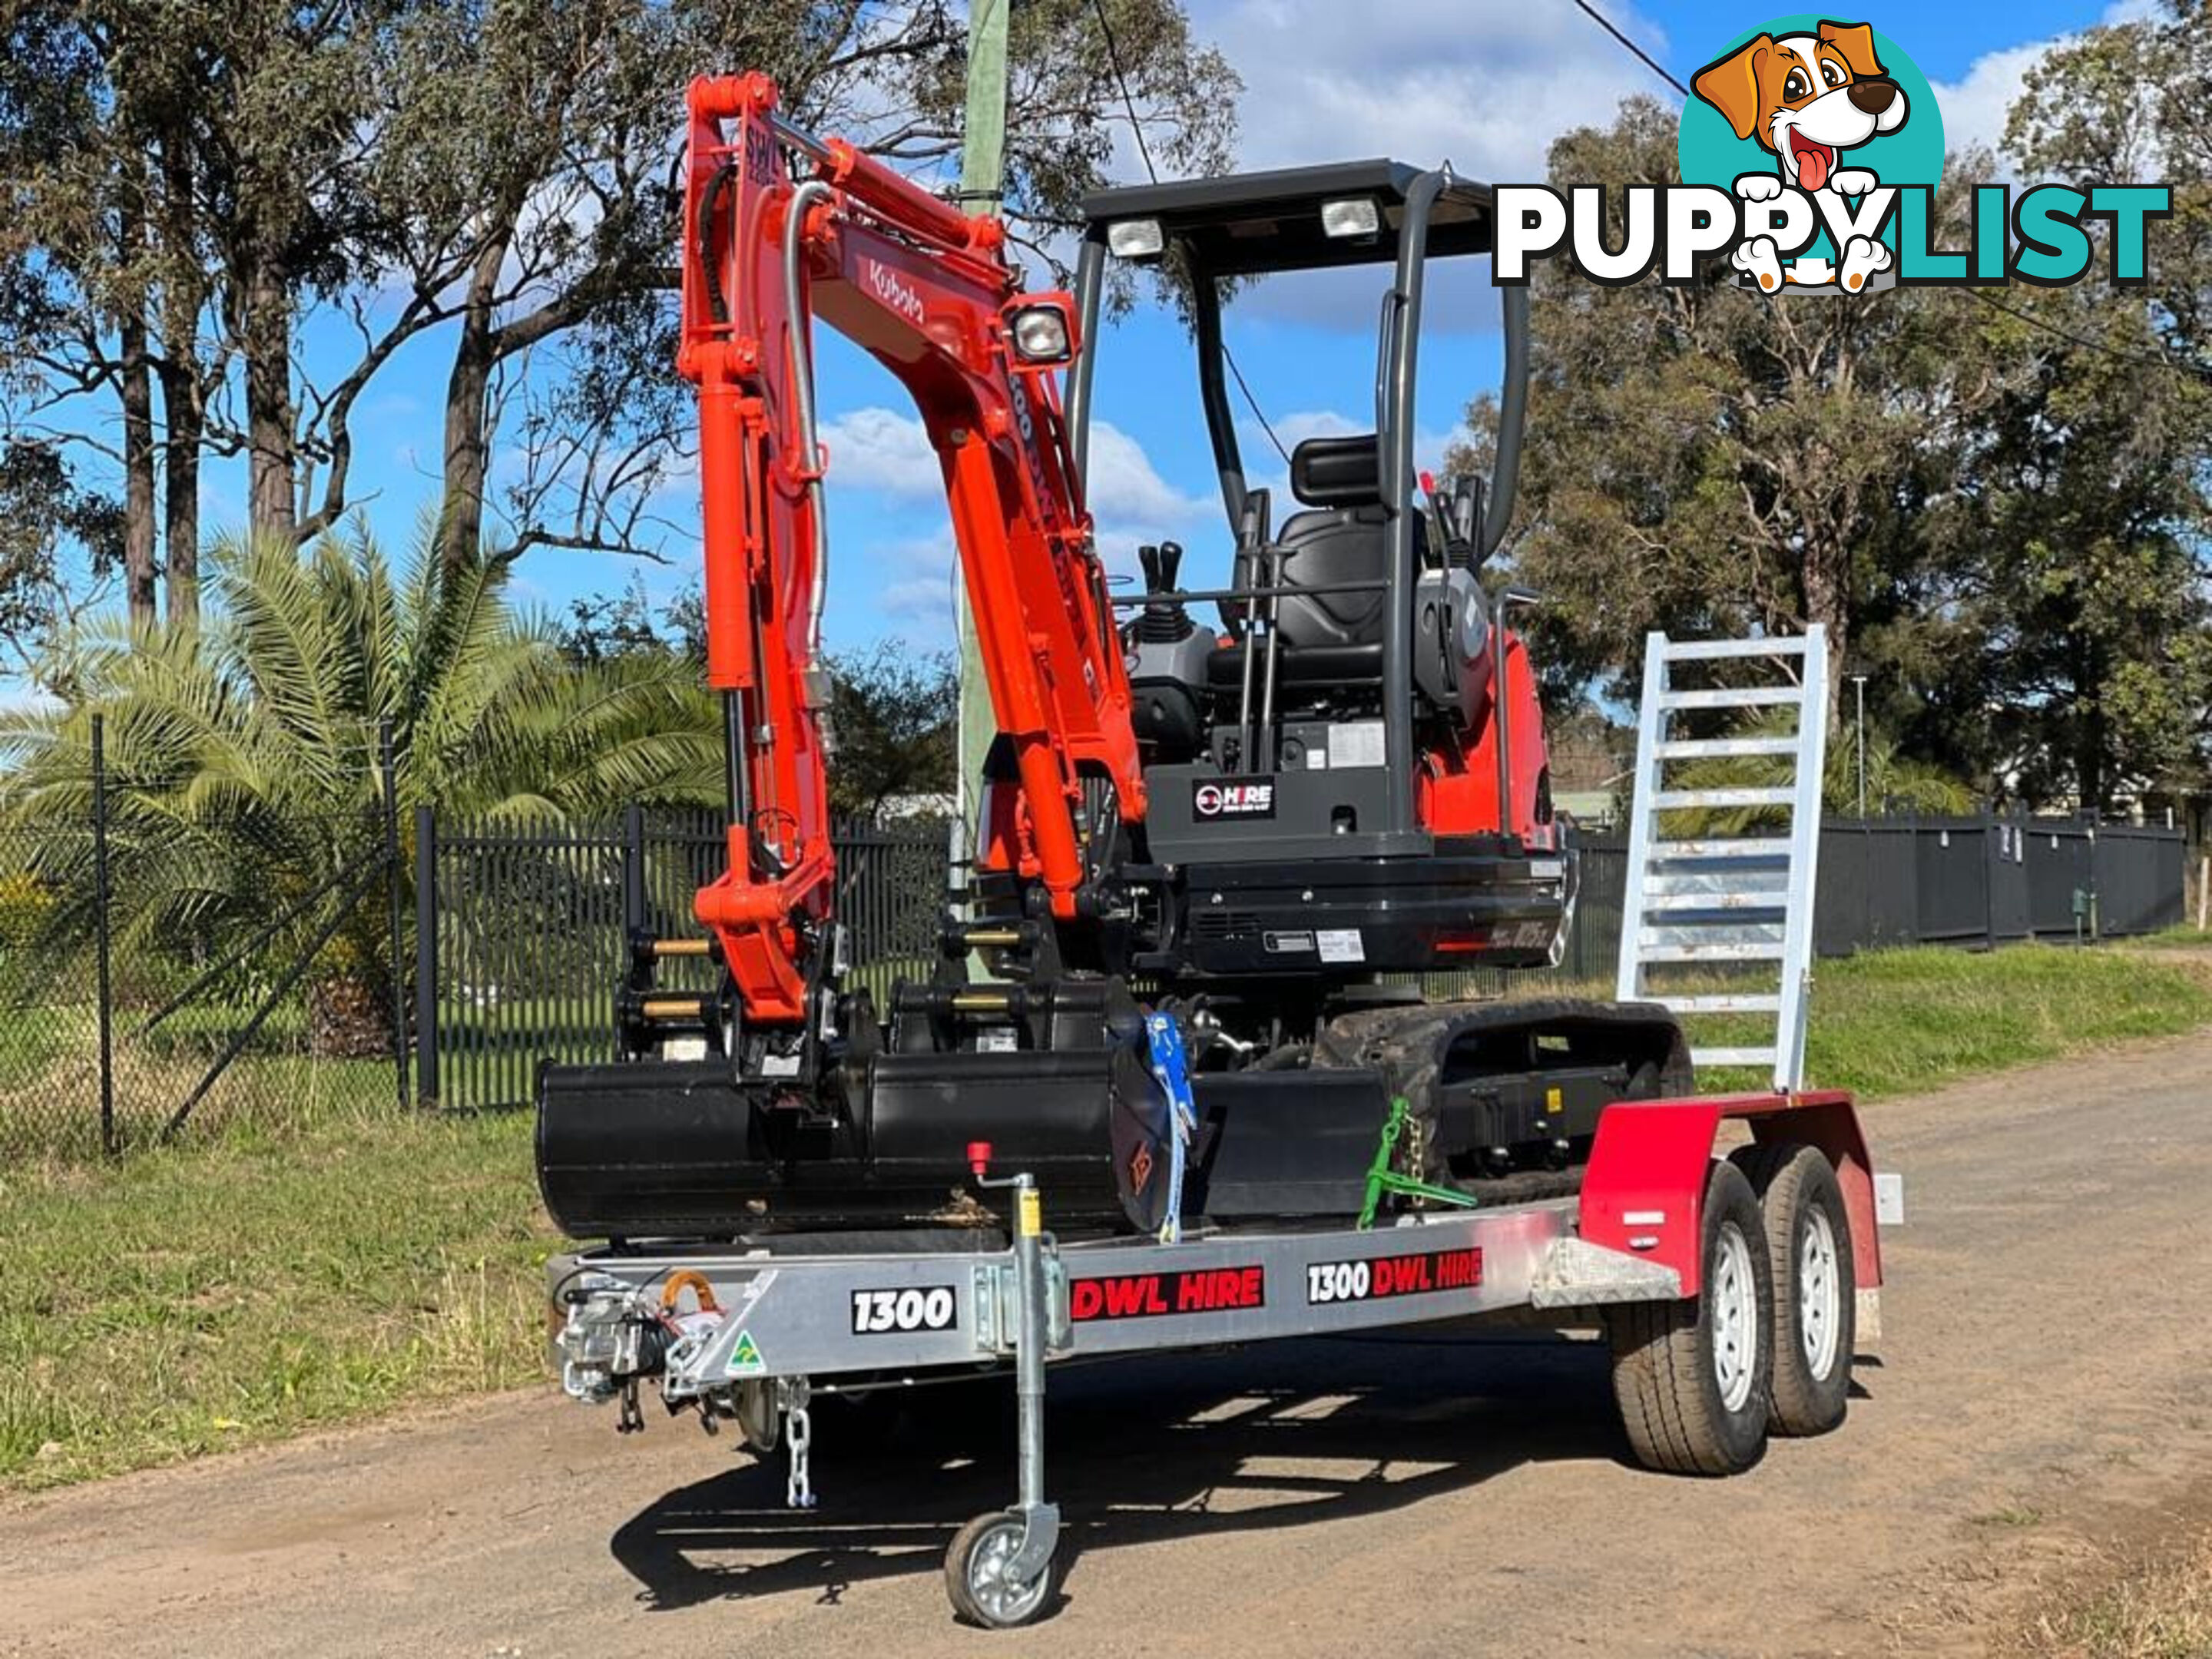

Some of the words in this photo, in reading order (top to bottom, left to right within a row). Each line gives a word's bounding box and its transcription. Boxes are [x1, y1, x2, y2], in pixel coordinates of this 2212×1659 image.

[870, 258, 923, 324] Kubota
[1224, 785, 1273, 804] HIRE
[1071, 1277, 1167, 1319] DWL
[1177, 1269, 1262, 1310] HIRE
[1308, 1261, 1370, 1302] 1300
[1373, 1256, 1432, 1296] DWL
[1436, 1248, 1482, 1288] HIRE
[855, 1288, 953, 1332] 1300
